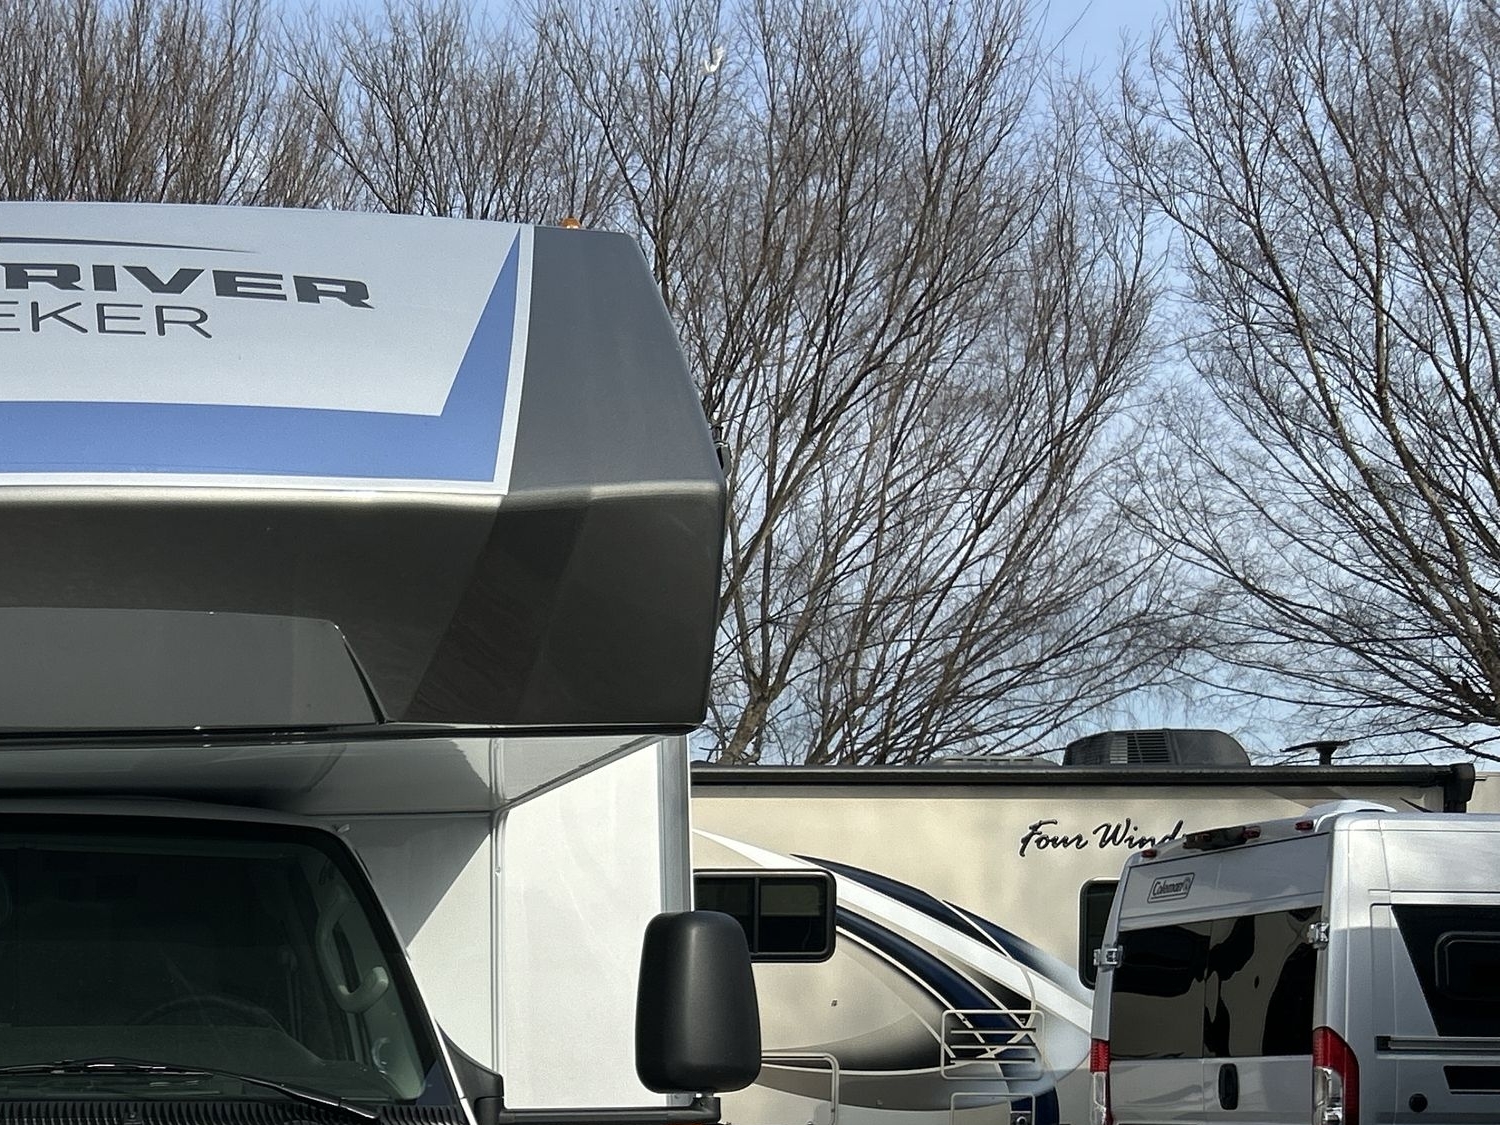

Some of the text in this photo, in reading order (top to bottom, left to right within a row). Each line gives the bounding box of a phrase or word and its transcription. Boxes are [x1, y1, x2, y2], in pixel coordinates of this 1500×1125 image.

[1018, 817, 1187, 858] Four Wind
[1152, 880, 1185, 896] Coleman
